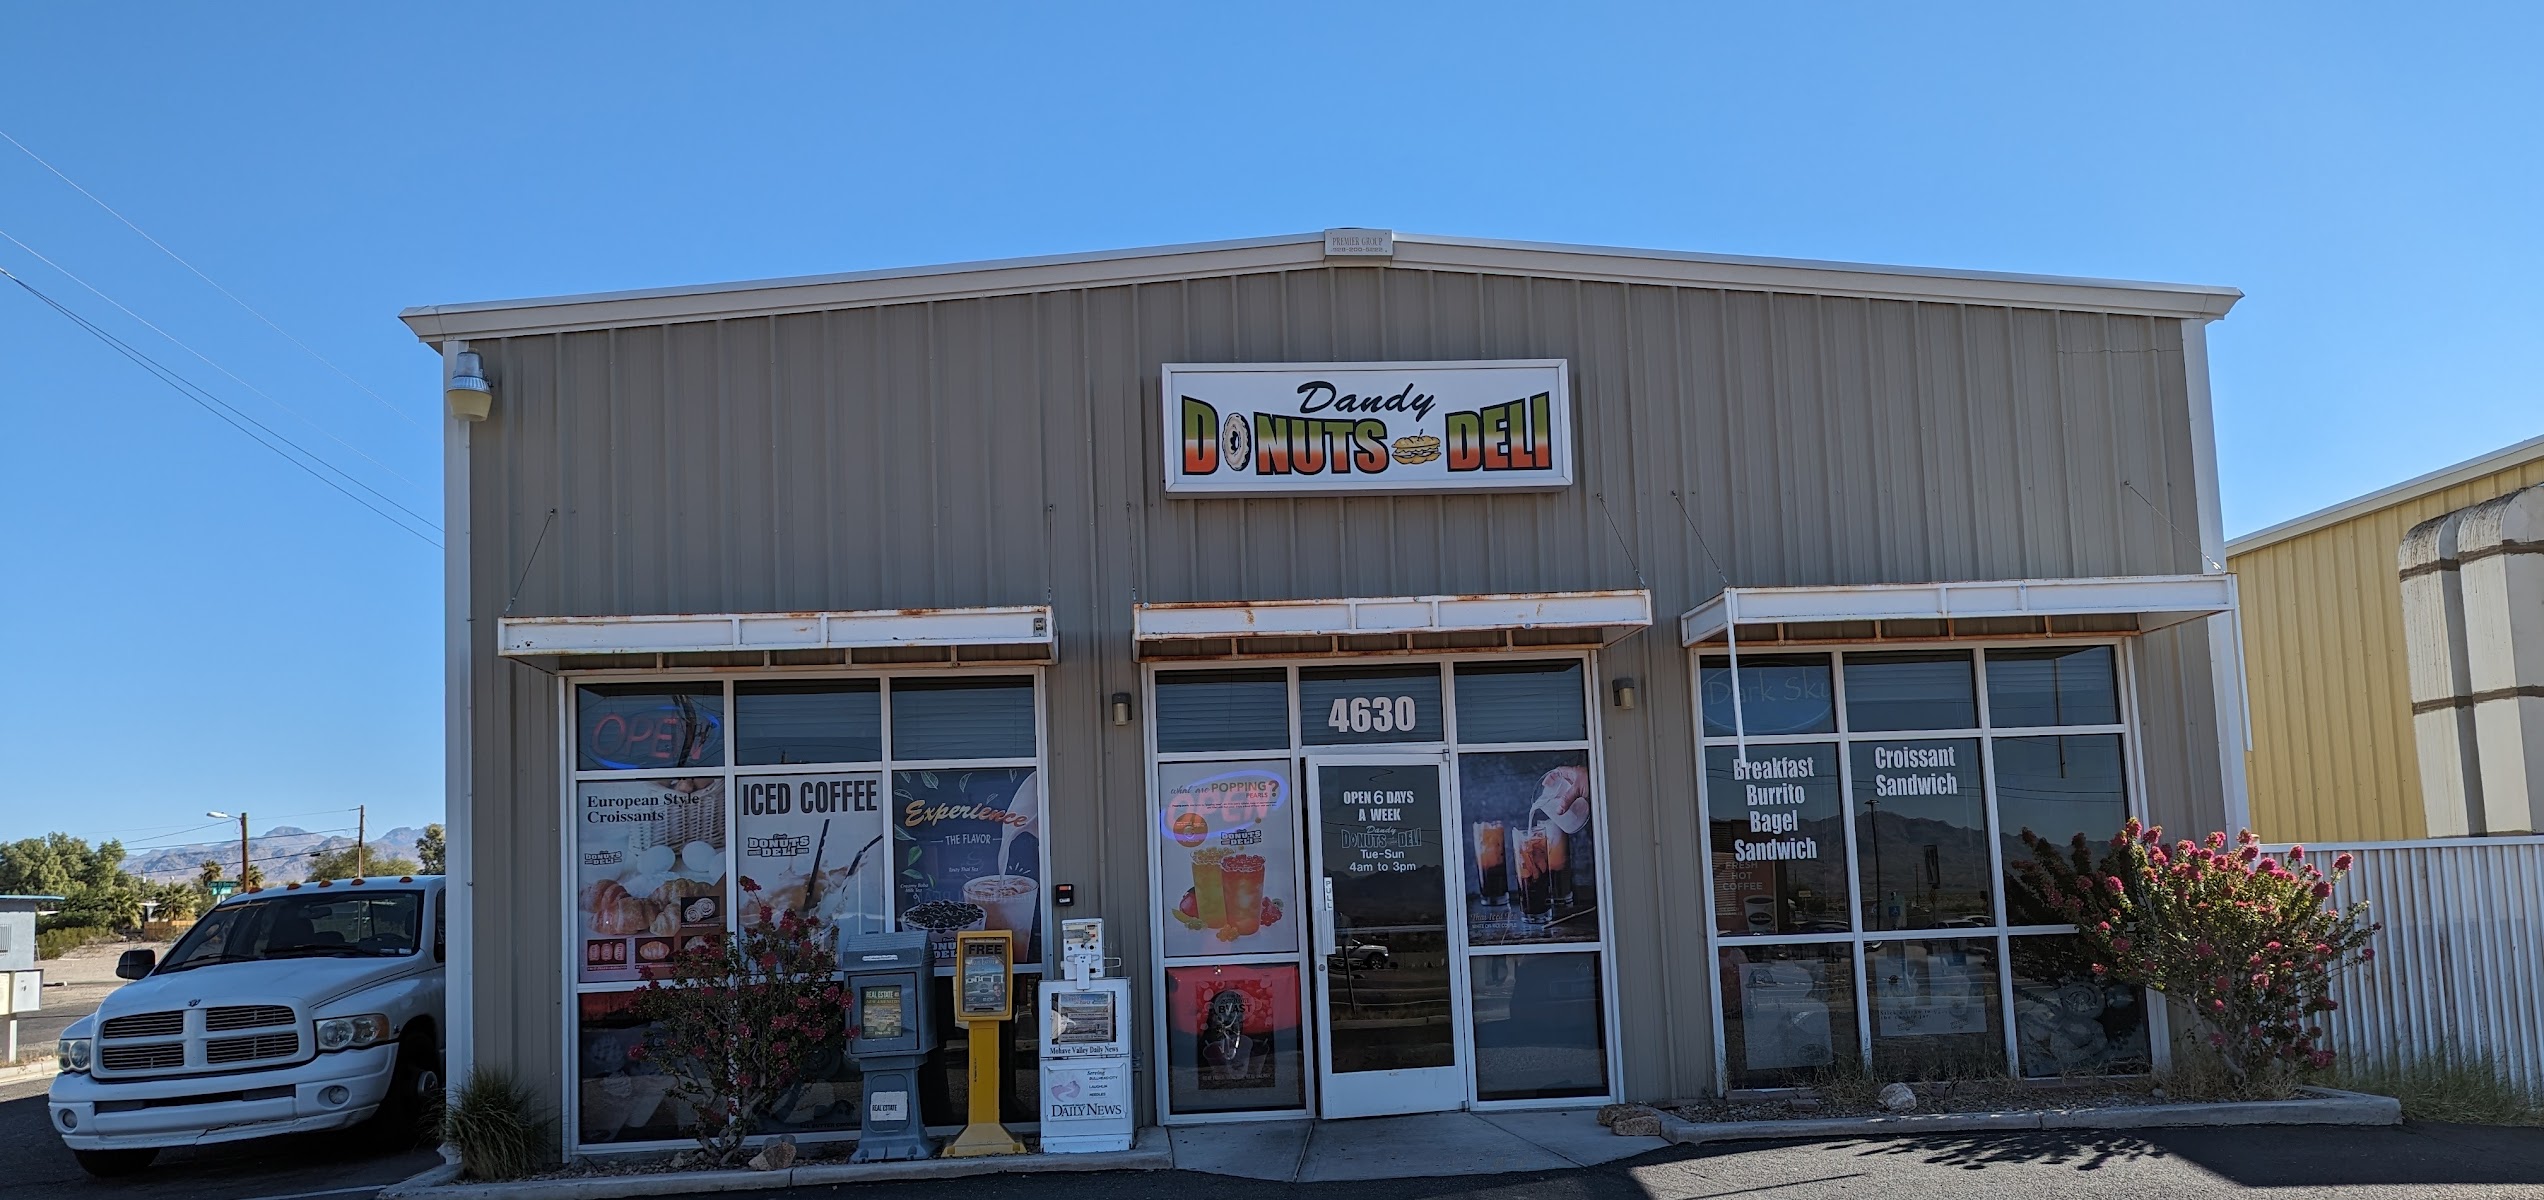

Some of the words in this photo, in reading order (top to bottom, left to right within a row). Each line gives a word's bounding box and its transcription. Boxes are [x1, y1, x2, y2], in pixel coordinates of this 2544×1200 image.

[1332, 237, 1360, 246] PREMIER
[1296, 380, 1436, 422] Dandy
[1445, 391, 1552, 472] DELI
[1328, 696, 1416, 733] 4630
[1875, 746, 1956, 769] Croissant
[1732, 757, 1814, 781] Breakfast
[1170, 784, 1192, 795] what
[1211, 781, 1267, 793] POPPING
[1875, 773, 1958, 797] Sandwich
[587, 794, 659, 809] European
[663, 792, 700, 807] Style
[743, 783, 791, 815] ICED
[800, 780, 878, 814] COFFEE
[1343, 791, 1372, 805] OPEN
[1373, 790, 1383, 805] 6
[1386, 790, 1415, 804] DAYS
[1745, 782, 1805, 806] Burrito
[587, 810, 664, 824] Croissants
[904, 799, 1028, 827] Experience
[1358, 809, 1366, 822] A
[1369, 808, 1401, 822] WEEK
[1749, 810, 1799, 834] Bagel
[1221, 830, 1261, 839] DONUTS
[1366, 825, 1397, 835] Dandy
[1398, 827, 1422, 847] DELI
[749, 837, 809, 848] DONUTS
[945, 835, 960, 845] THE
[961, 834, 991, 845] FLAVOR
[585, 851, 621, 860] DONUTS
[762, 847, 797, 856] DELI
[1360, 849, 1405, 859] Tue-Sun
[1734, 837, 1817, 862] Sandwich
[1349, 862, 1373, 872] 4am
[1377, 862, 1388, 871] to
[1392, 862, 1416, 873] 3pm
[1725, 861, 1758, 869] FRESH
[1731, 872, 1753, 880] HOT
[1722, 882, 1763, 890] COFFEE
[931, 942, 956, 950] ONU
[968, 944, 1002, 955] FREE
[933, 950, 957, 958] DEL
[1050, 1046, 1071, 1054] Mohave
[1072, 1046, 1088, 1055] Valley
[1089, 1046, 1103, 1054] Daily
[1104, 1045, 1119, 1053] News
[1051, 1104, 1086, 1117] DAILY
[1086, 1103, 1122, 1116] NEWS
